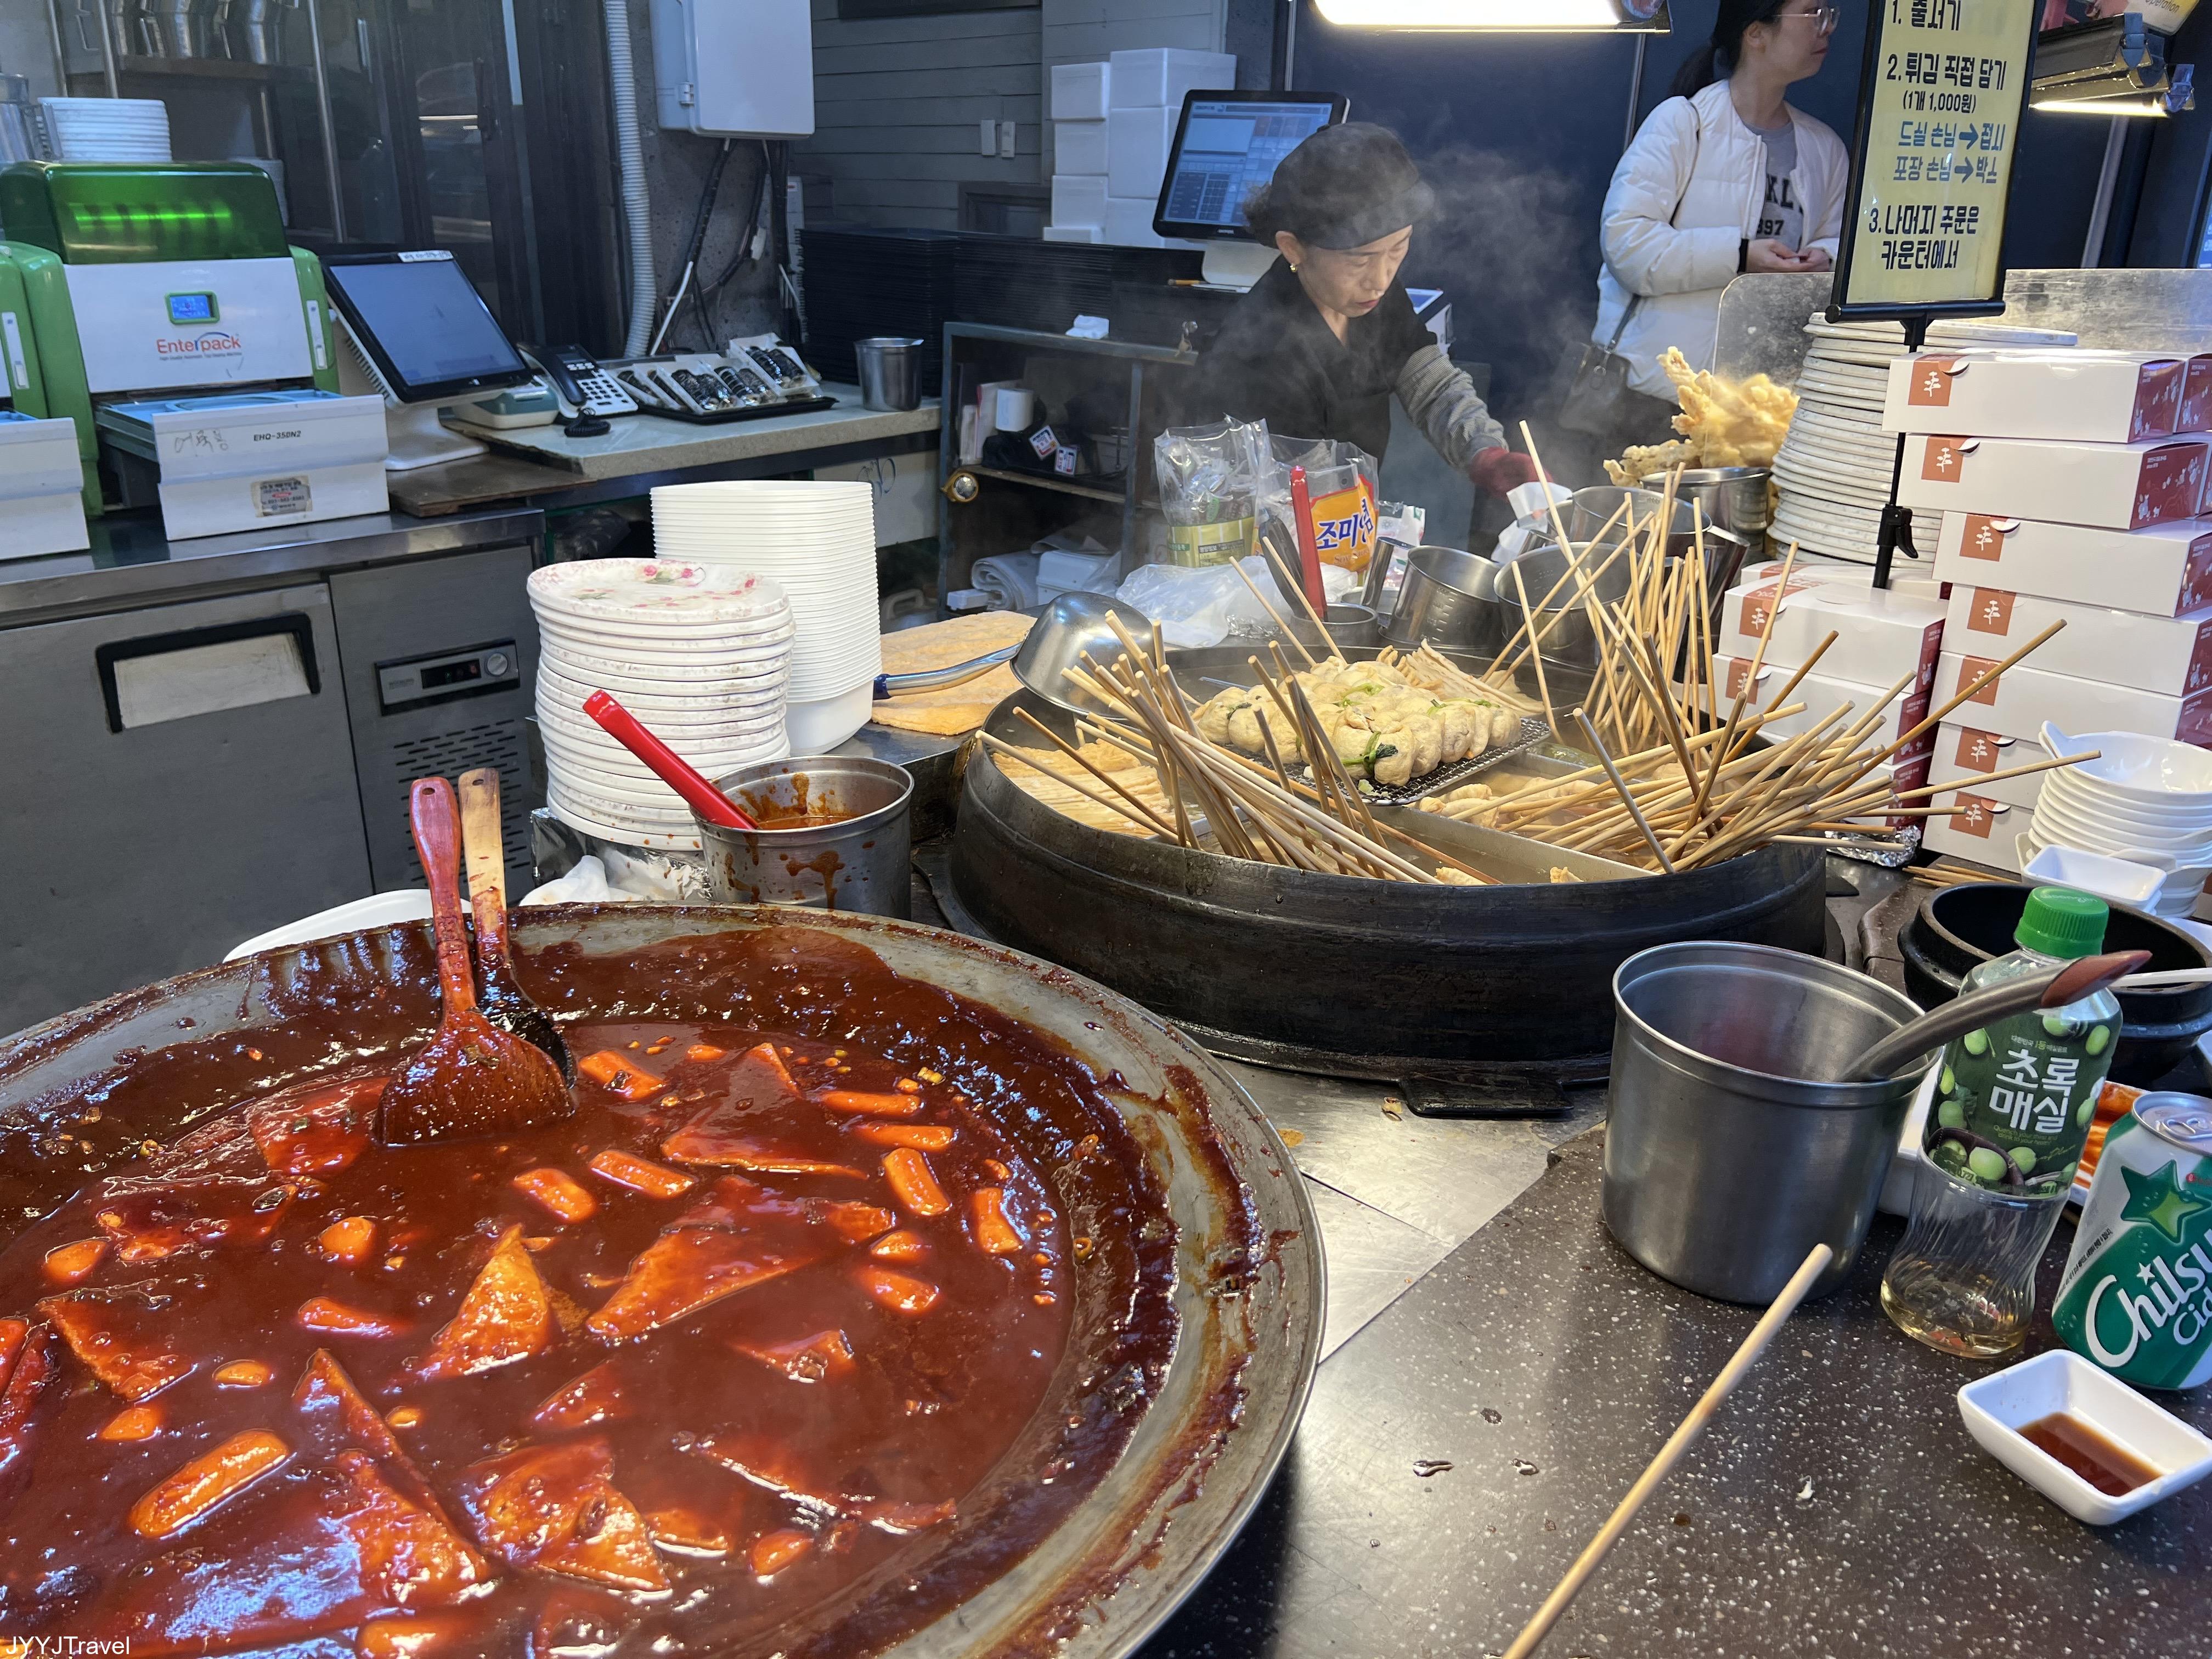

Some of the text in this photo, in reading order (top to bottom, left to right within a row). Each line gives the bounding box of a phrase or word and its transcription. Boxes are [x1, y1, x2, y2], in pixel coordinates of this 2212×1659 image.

[1911, 0, 1961, 31] 줄서기
[1887, 52, 2007, 90] 2. 튀김 직접 담기
[1903, 90, 1976, 114] (1개 1,000원)
[1898, 121, 2006, 151] 드실 손님 접시
[1893, 156, 1997, 183] 포장 손님 박스
[1869, 205, 1979, 234] 3. 나머지 주문은
[1881, 240, 1960, 269] 카운터에서
[157, 332, 241, 353] Enterpack
[1996, 1048, 2079, 1097] 초록
[1989, 1086, 2068, 1133] 매실
